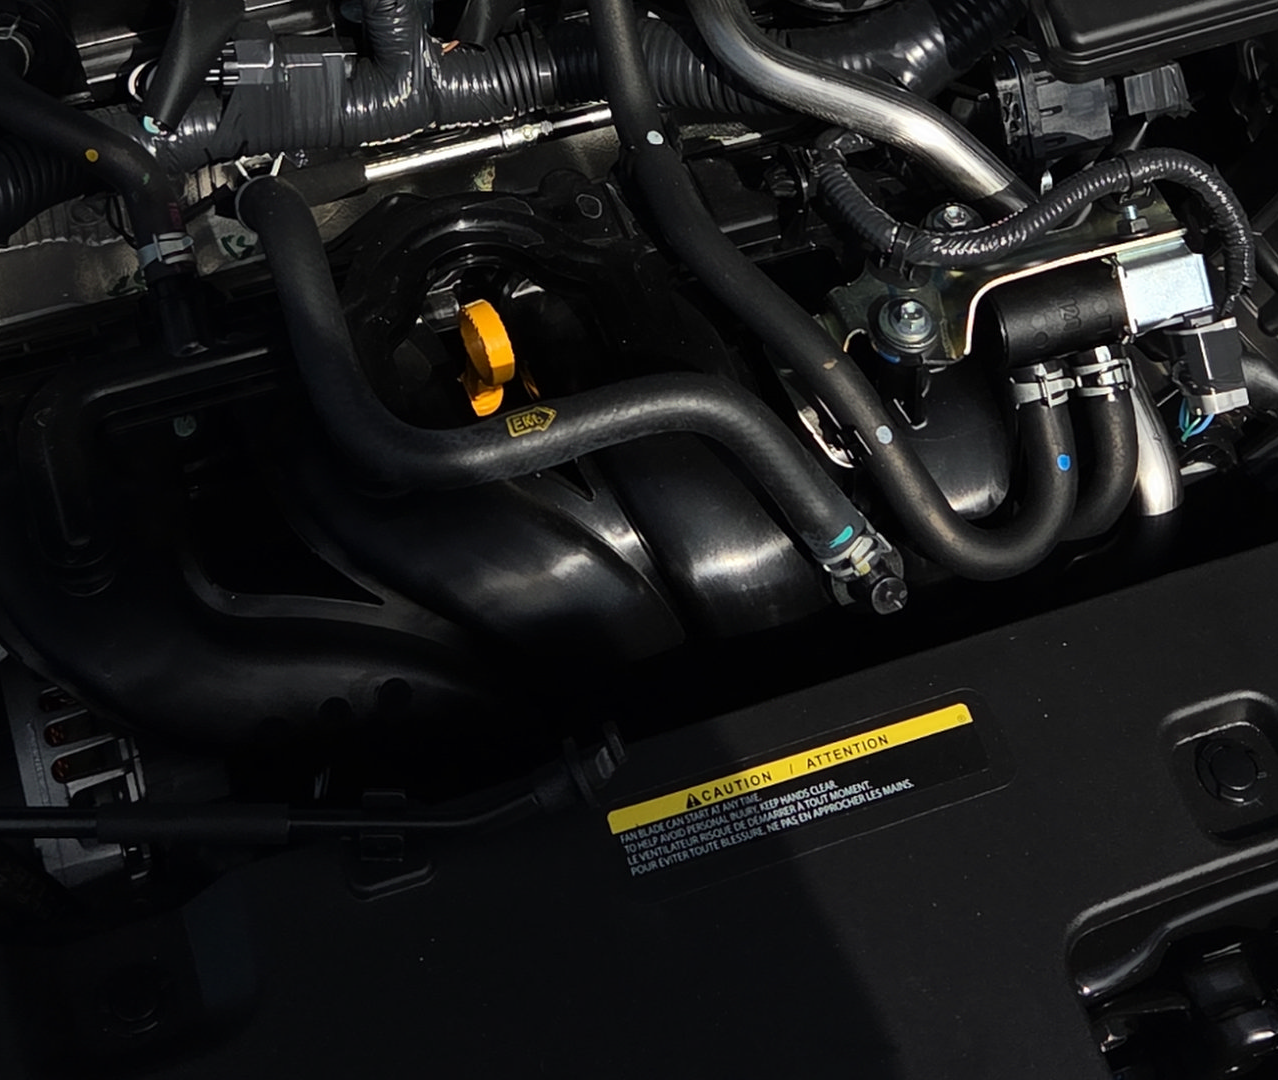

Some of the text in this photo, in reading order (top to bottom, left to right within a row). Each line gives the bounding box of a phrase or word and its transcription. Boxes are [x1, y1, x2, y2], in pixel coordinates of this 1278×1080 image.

[702, 771, 772, 802] CAUTION
[806, 734, 889, 770] ATTENTION
[620, 793, 762, 845] FAN BLADE CAN START AT ANY TIME.
[624, 844, 637, 855] TO
[638, 837, 658, 851] HELP
[660, 829, 687, 843] AVOID
[687, 816, 727, 835] PERSONAL
[760, 797, 780, 811] KEEP
[780, 788, 810, 806] HANDS
[627, 854, 640, 867] LE
[639, 836, 700, 863] VENTILATEUR
[700, 825, 733, 844] RISQUE
[733, 821, 747, 833] DE
[805, 794, 829, 810] TOUT
[829, 780, 873, 801] MOMENT.
[630, 861, 658, 876] POUR
[690, 841, 720, 858] TOUTE
[767, 822, 781, 834] NE
[799, 810, 813, 823] EN
[813, 795, 866, 818] APPROCHER
[867, 788, 882, 802] LES
[882, 778, 915, 797] MAINS.
